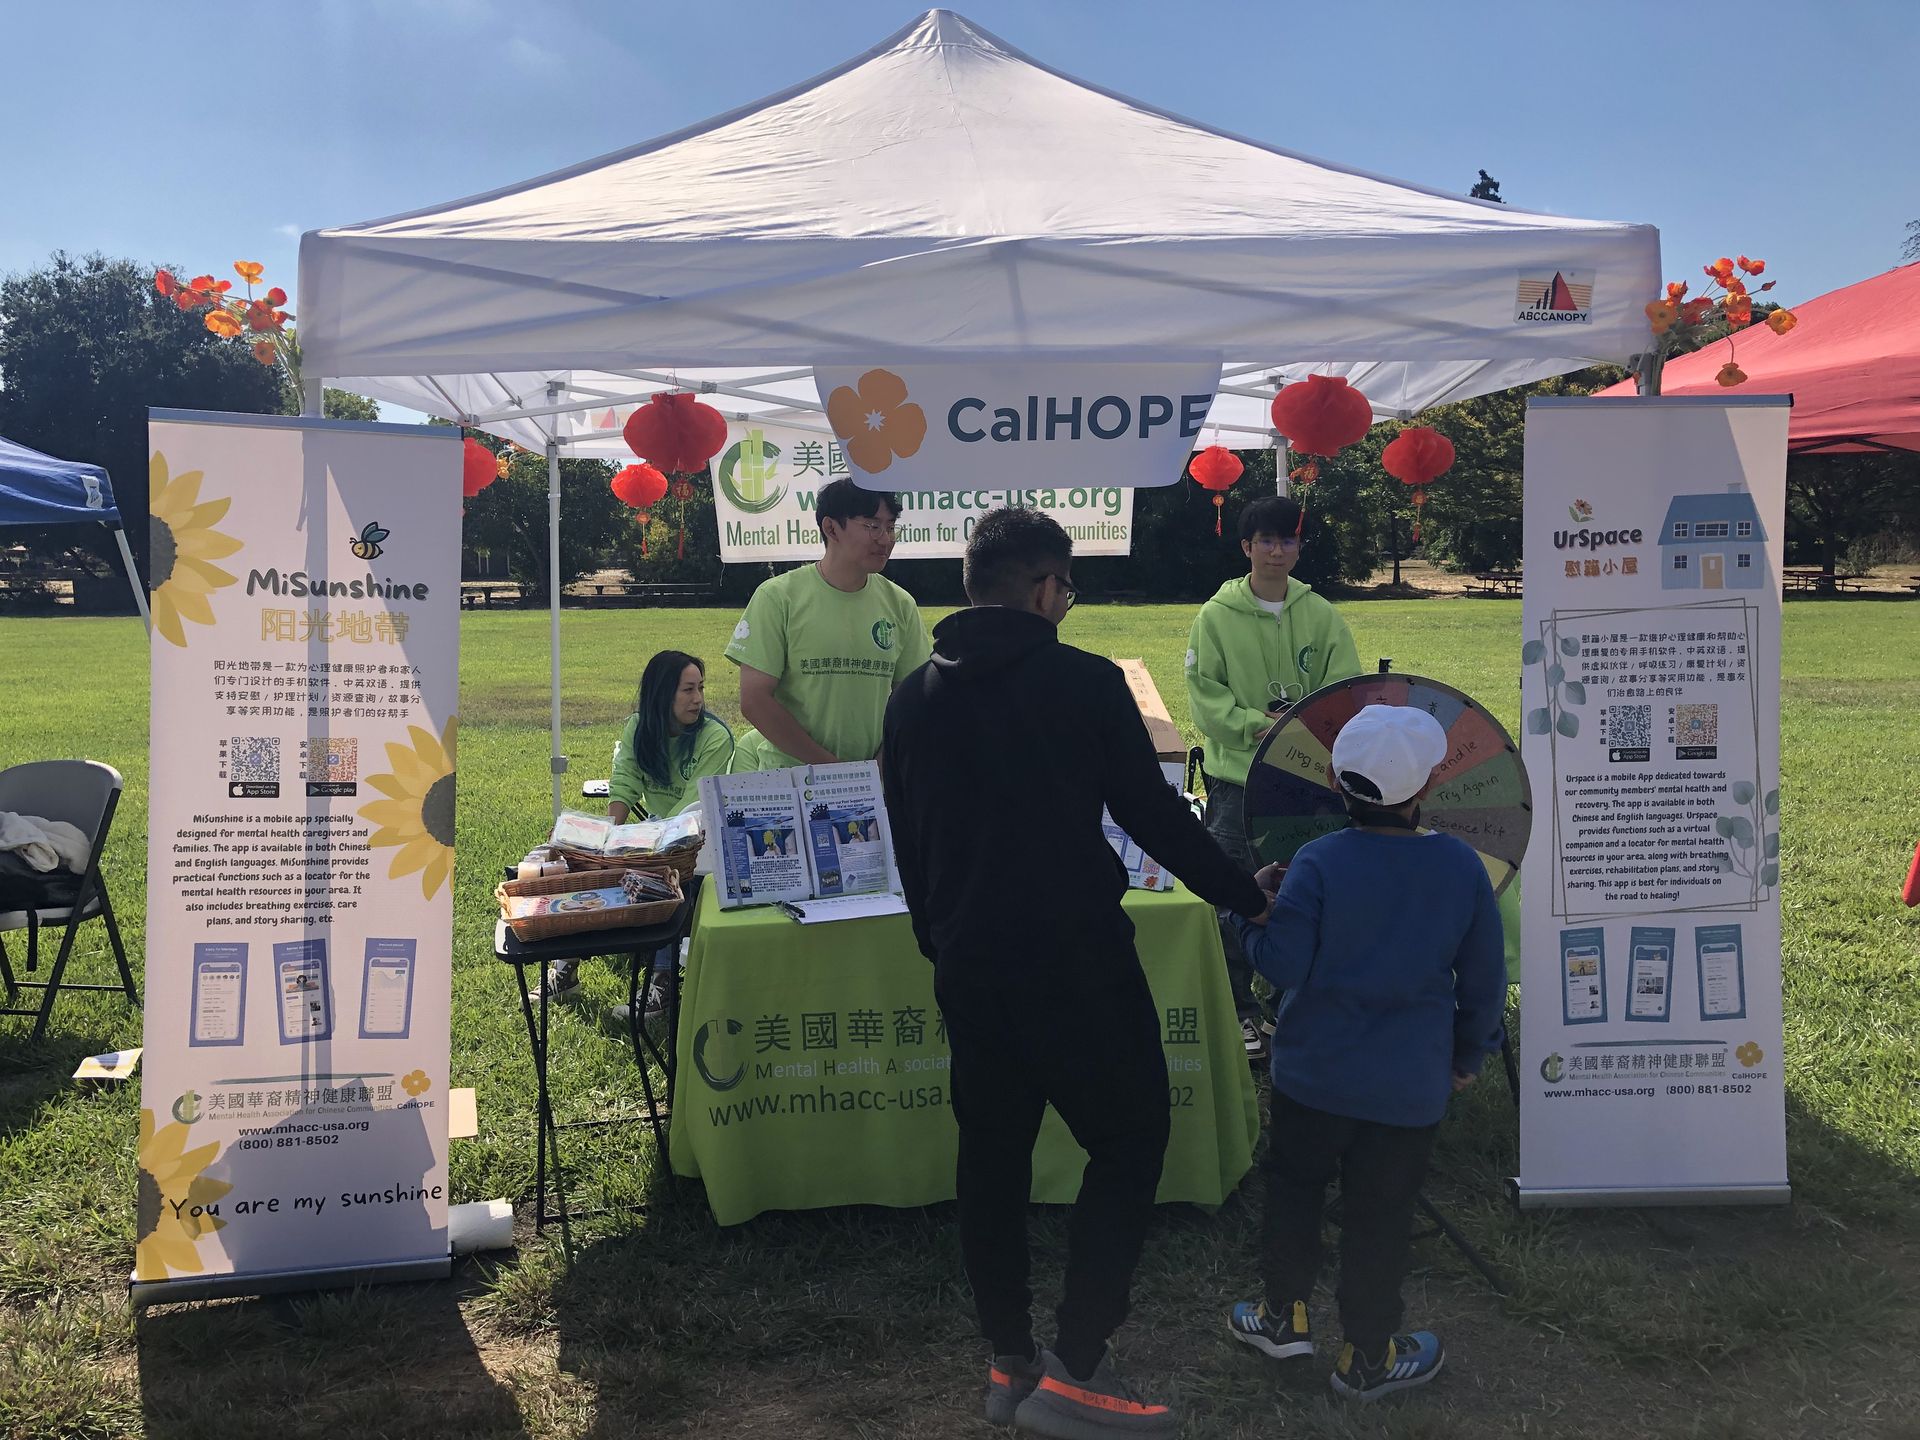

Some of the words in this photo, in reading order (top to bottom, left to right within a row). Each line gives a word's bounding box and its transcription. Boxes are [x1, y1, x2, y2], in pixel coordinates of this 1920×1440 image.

[1518, 312, 1587, 321] ABCCANOPY
[947, 394, 1212, 442] CalHOPE
[727, 520, 780, 547] Mental
[937, 522, 957, 542] for
[1554, 528, 1642, 551] UrSpace
[247, 568, 429, 601] MiSunshine
[261, 608, 410, 644] 阳光地带
[1286, 746, 1312, 769] Ball
[1437, 741, 1478, 776] andle
[1565, 774, 1595, 784] Urspace
[1596, 773, 1603, 781] is
[1610, 772, 1636, 781] mobile
[1637, 772, 1654, 783] App
[1655, 771, 1691, 780] dedicated
[1692, 770, 1726, 779] towards
[1437, 790, 1460, 802] Try
[1462, 774, 1500, 796] Again
[1578, 786, 1619, 797] community
[1657, 784, 1683, 793] mental
[1684, 784, 1710, 792] health
[1711, 783, 1727, 792] and
[1611, 799, 1625, 808] The
[1627, 800, 1642, 809] app
[1643, 799, 1650, 807] is
[1651, 798, 1686, 807] available
[1687, 798, 1694, 806] in
[1696, 797, 1715, 806] both
[192, 814, 244, 823] MiSunshine
[245, 815, 253, 823] is
[254, 815, 261, 823] a
[263, 814, 293, 823] mobile
[294, 815, 312, 825] app
[314, 814, 354, 825] specially
[1430, 816, 1479, 835] Science
[1483, 823, 1507, 836] Kit
[176, 828, 218, 841] designed
[219, 828, 235, 838] for
[236, 828, 268, 837] mental
[270, 828, 300, 837] health
[302, 829, 350, 840] caregivers
[351, 828, 368, 837] and
[212, 843, 229, 852] The
[231, 844, 249, 854] app
[251, 843, 258, 852] is
[260, 843, 302, 852] available
[304, 842, 313, 851] in
[315, 842, 336, 851] both
[338, 842, 371, 851] Chinese
[174, 858, 192, 867] and
[194, 858, 228, 870] English
[280, 857, 329, 866] MiSunshine
[331, 856, 369, 867] provides
[172, 873, 215, 884] practical
[217, 872, 260, 881] functions
[261, 872, 282, 881] such
[284, 873, 294, 881] as
[295, 873, 302, 881] a
[304, 871, 337, 880] locator
[338, 870, 353, 880] for
[354, 871, 371, 880] the
[181, 887, 214, 896] mental
[216, 886, 246, 896] health
[248, 887, 292, 895] resources
[294, 886, 302, 895] in
[304, 887, 327, 897] your
[352, 885, 362, 894] It
[1604, 892, 1618, 901] the
[1619, 891, 1638, 900] road
[1639, 891, 1648, 900] to
[185, 903, 204, 911] also
[206, 901, 243, 910] includes
[245, 901, 291, 912] breathing
[337, 900, 357, 908] care
[234, 915, 252, 924] and
[253, 915, 278, 927] story
[756, 1060, 817, 1080] Mental
[824, 1056, 880, 1076] Health
[208, 1085, 393, 1111] 美國華裔精神健康聯盟
[1544, 1086, 1655, 1099] www.mhacc-usa.org
[1666, 1085, 1695, 1096] (800)
[1698, 1084, 1752, 1095] 881-8502
[209, 1113, 235, 1121] Mental
[237, 1111, 261, 1119] Health
[262, 1108, 304, 1118] Association
[306, 1107, 316, 1115] for
[317, 1106, 345, 1114] Chinese
[346, 1104, 392, 1113] Communities
[397, 1101, 435, 1110] CalHOPE
[238, 1120, 370, 1137] www.mhacc-usa.org
[239, 1138, 273, 1151] (800)
[277, 1134, 339, 1148] 881-8502
[169, 1198, 220, 1220] You
[235, 1197, 280, 1216] are
[294, 1196, 326, 1216] my
[341, 1183, 443, 1208] sunshine
